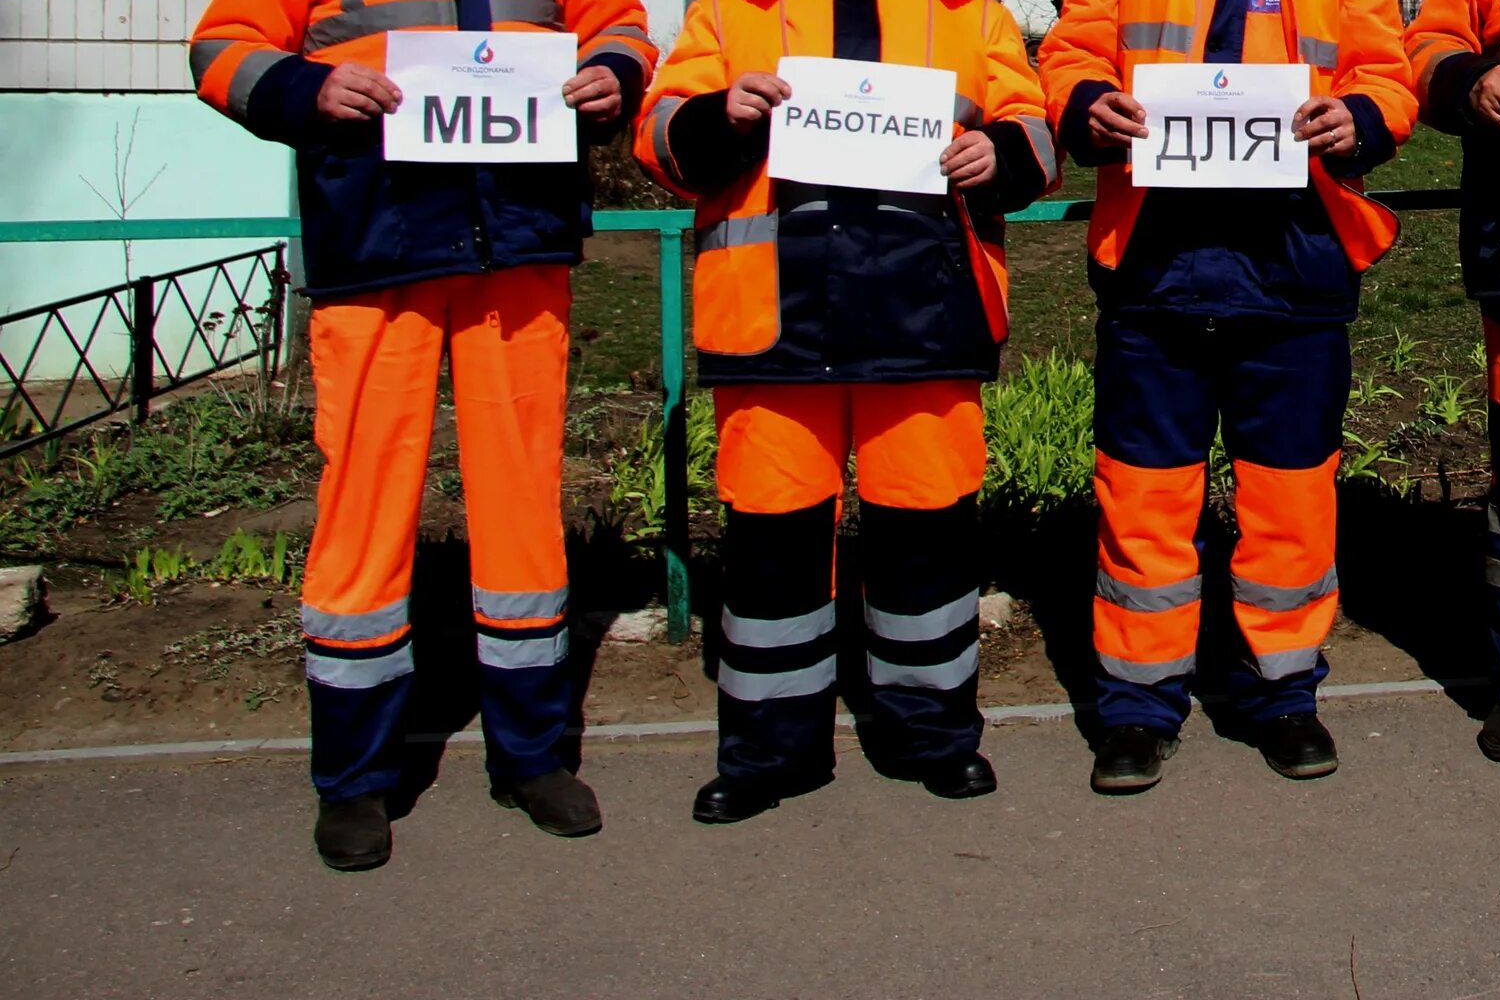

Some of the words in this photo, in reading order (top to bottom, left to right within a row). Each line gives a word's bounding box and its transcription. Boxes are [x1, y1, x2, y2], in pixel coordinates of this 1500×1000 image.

[423, 95, 538, 144] МЫ
[786, 106, 943, 139] РАБОТАЕМ
[1156, 116, 1281, 171] ДЛЯ
